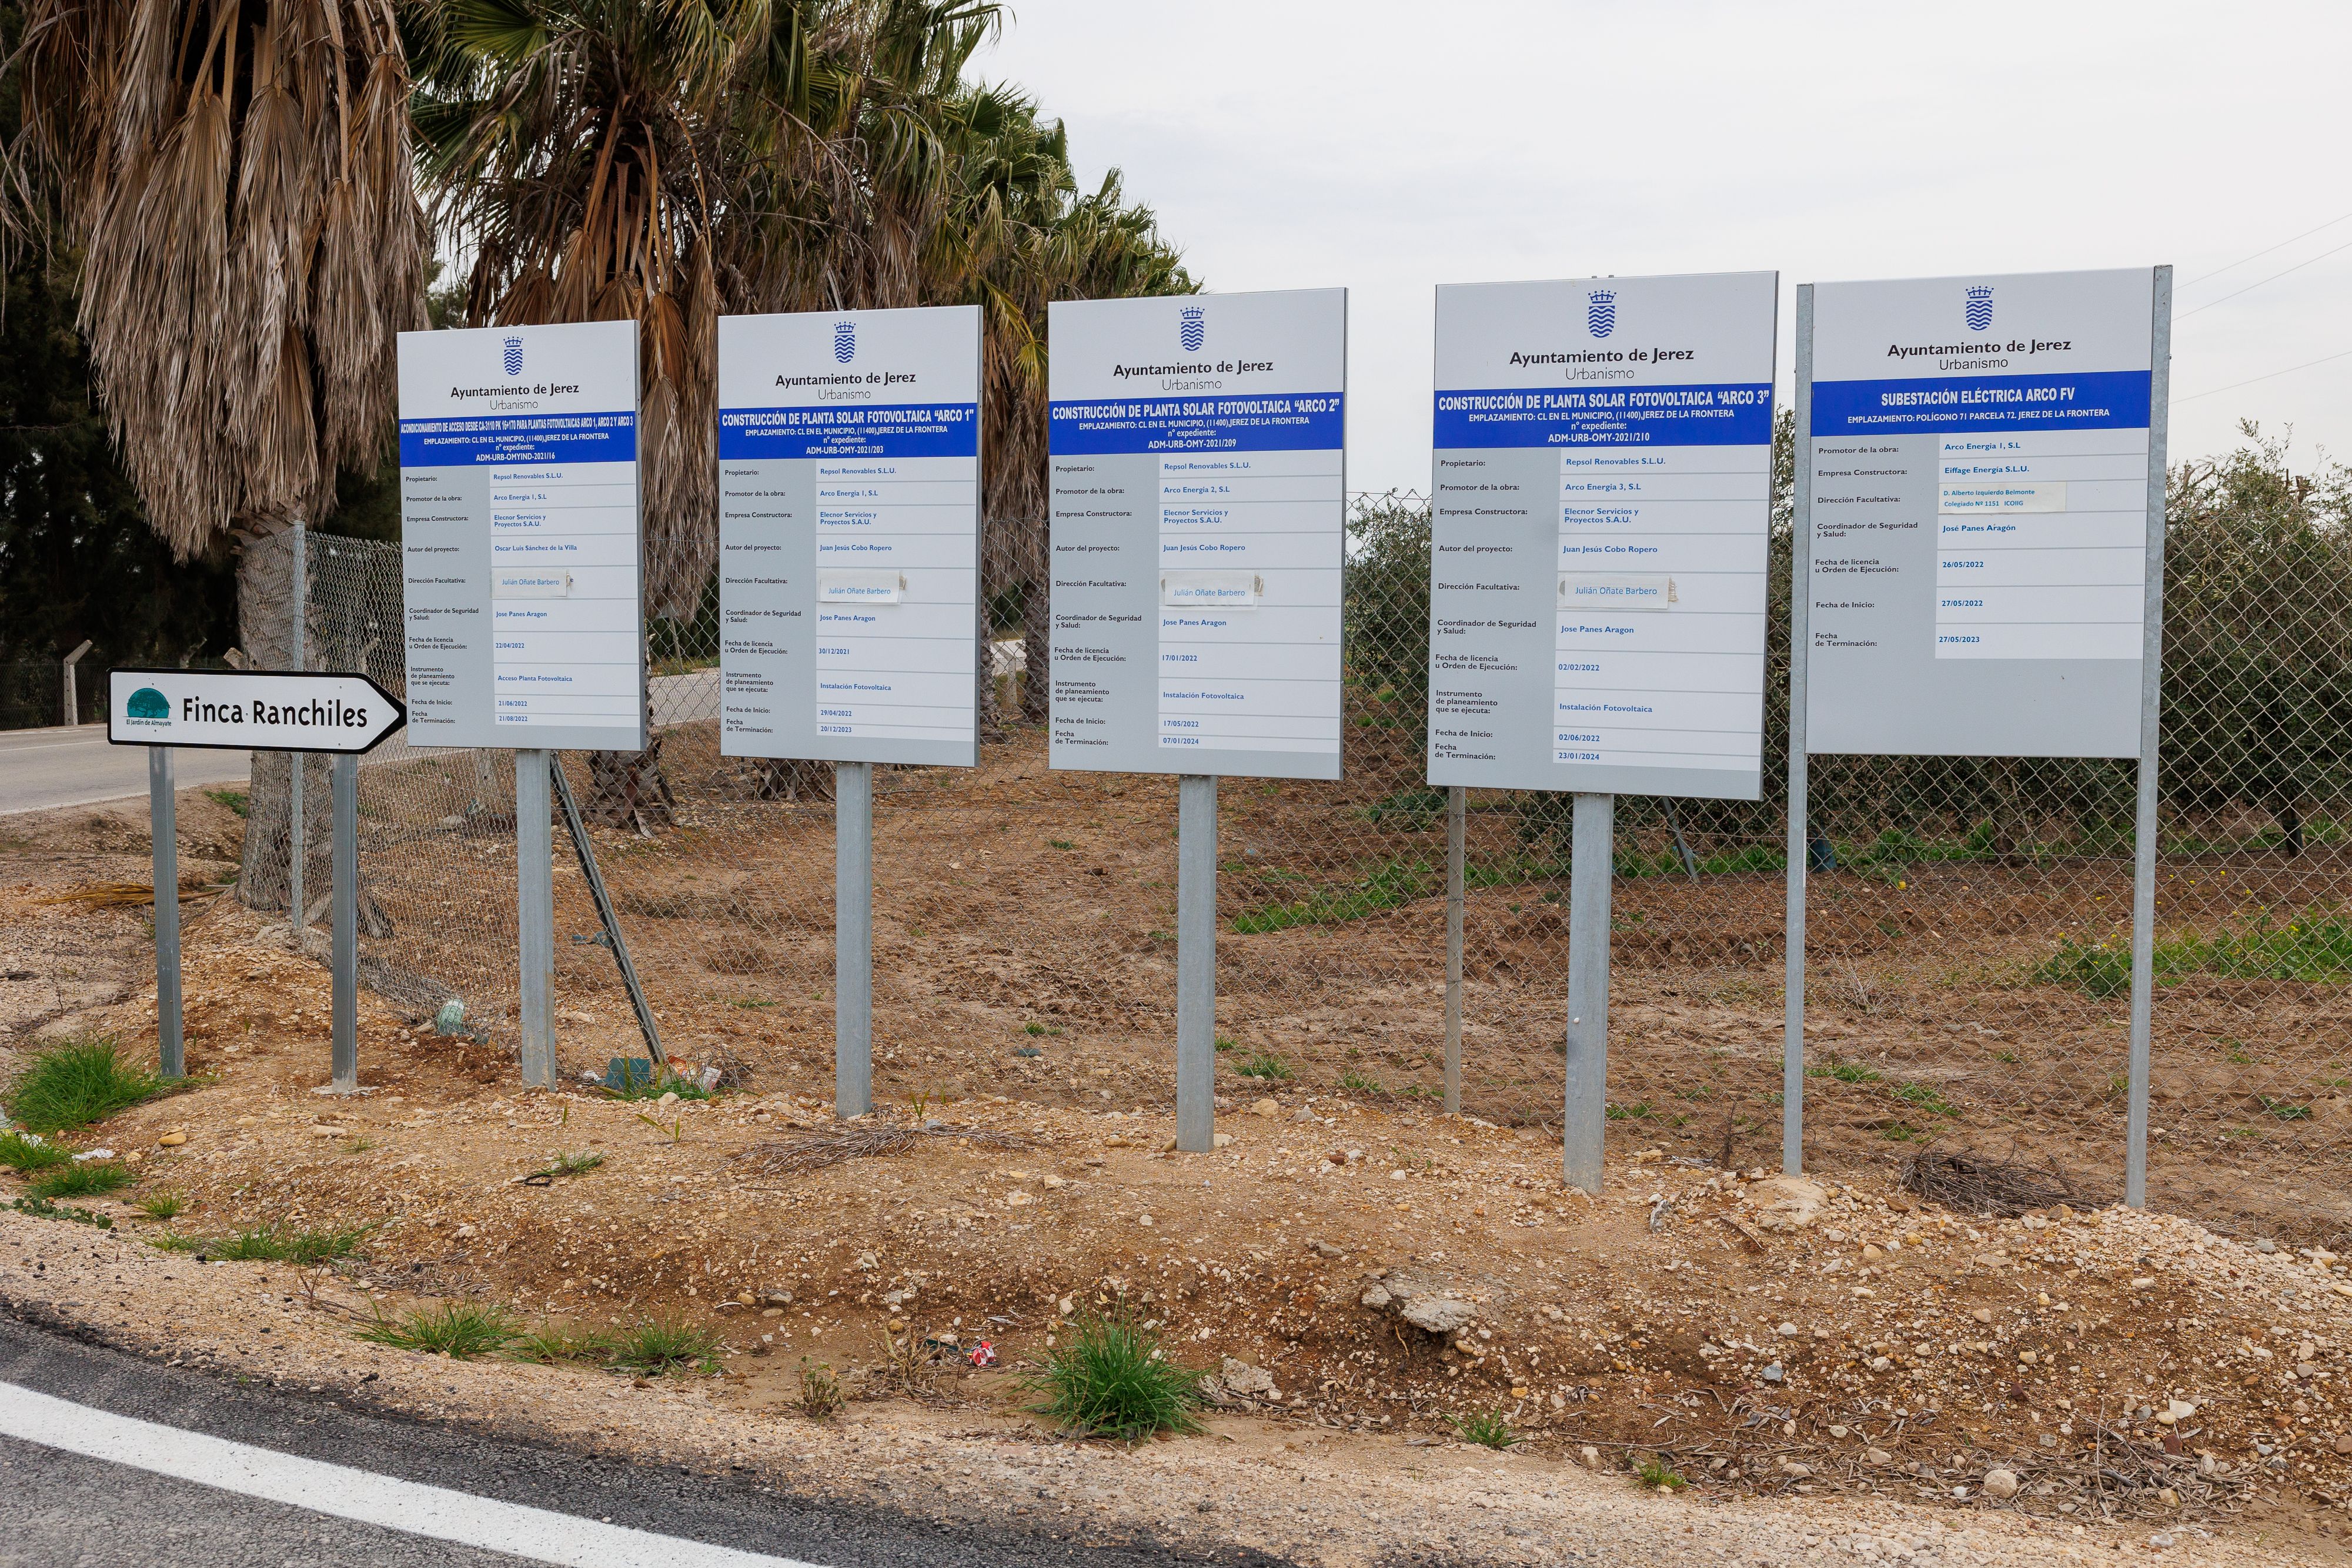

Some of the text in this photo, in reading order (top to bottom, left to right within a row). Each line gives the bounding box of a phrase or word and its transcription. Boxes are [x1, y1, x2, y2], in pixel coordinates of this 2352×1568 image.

[1887, 339, 2071, 359] Ayuntamiento de Jerez
[1509, 347, 1693, 367] Ayuntamiento de Jerez
[1113, 360, 1273, 379] Ayuntamiento de Jerez
[1940, 357, 2008, 370] Urbanismo
[1566, 367, 1634, 380] Urbanismo
[775, 372, 916, 389] Ayuntamiento de Jerez
[1162, 378, 1221, 390] Urbanismo
[450, 383, 579, 399] Ayuntamiento de Jerez
[818, 388, 870, 399] Urbanismo
[1881, 387, 2075, 406] SUBESTACIÓN ELÉCTRICA ARCO FV
[490, 399, 538, 410] Urbanismo
[1439, 392, 1523, 410] CONSTRUCCIÓN
[1526, 394, 1541, 408] DE
[1544, 394, 1586, 408] PLANTA
[1589, 393, 1625, 407] SOLAR
[1629, 391, 1713, 406] FOTOVOLTAICA
[1053, 402, 1125, 420] CONSTRUCCIÓN
[1128, 404, 1141, 417] DE
[1144, 403, 1180, 417] PLANTA
[1182, 402, 1214, 416] SOLAR
[1218, 400, 1291, 414] FOTOVOLTAICA
[1847, 414, 1915, 423] EMPLAZAMIENTO:
[1916, 412, 1957, 421] POLÍGONO
[1969, 412, 2004, 420] PARCELA
[2017, 410, 2040, 420] JEREZ
[2067, 409, 2110, 417] FRONTERA
[722, 410, 786, 426] CONSTRUCCIÓN
[789, 413, 800, 424] DE
[802, 412, 834, 424] PLANTA
[836, 411, 864, 423] SOLAR
[867, 410, 931, 423] FOTOVOLTAICA
[831, 435, 866, 445] expediente:
[1548, 432, 1649, 442] ADM-URB-OMY-2021/210
[805, 445, 883, 454] ADM-URB-OMY-2021/203
[1148, 439, 1236, 449] ADM-URB-OMY-2021/209
[475, 453, 556, 462] ADM-URB-OMYIND-2021/16
[1566, 458, 1592, 467] Repsol
[1879, 521, 1917, 530] Seguridad
[1986, 523, 2015, 532] Aragón
[1628, 546, 1657, 554] Ropero
[1860, 566, 1899, 574] Ejecución:
[183, 696, 367, 727] Finca Ranchiles
